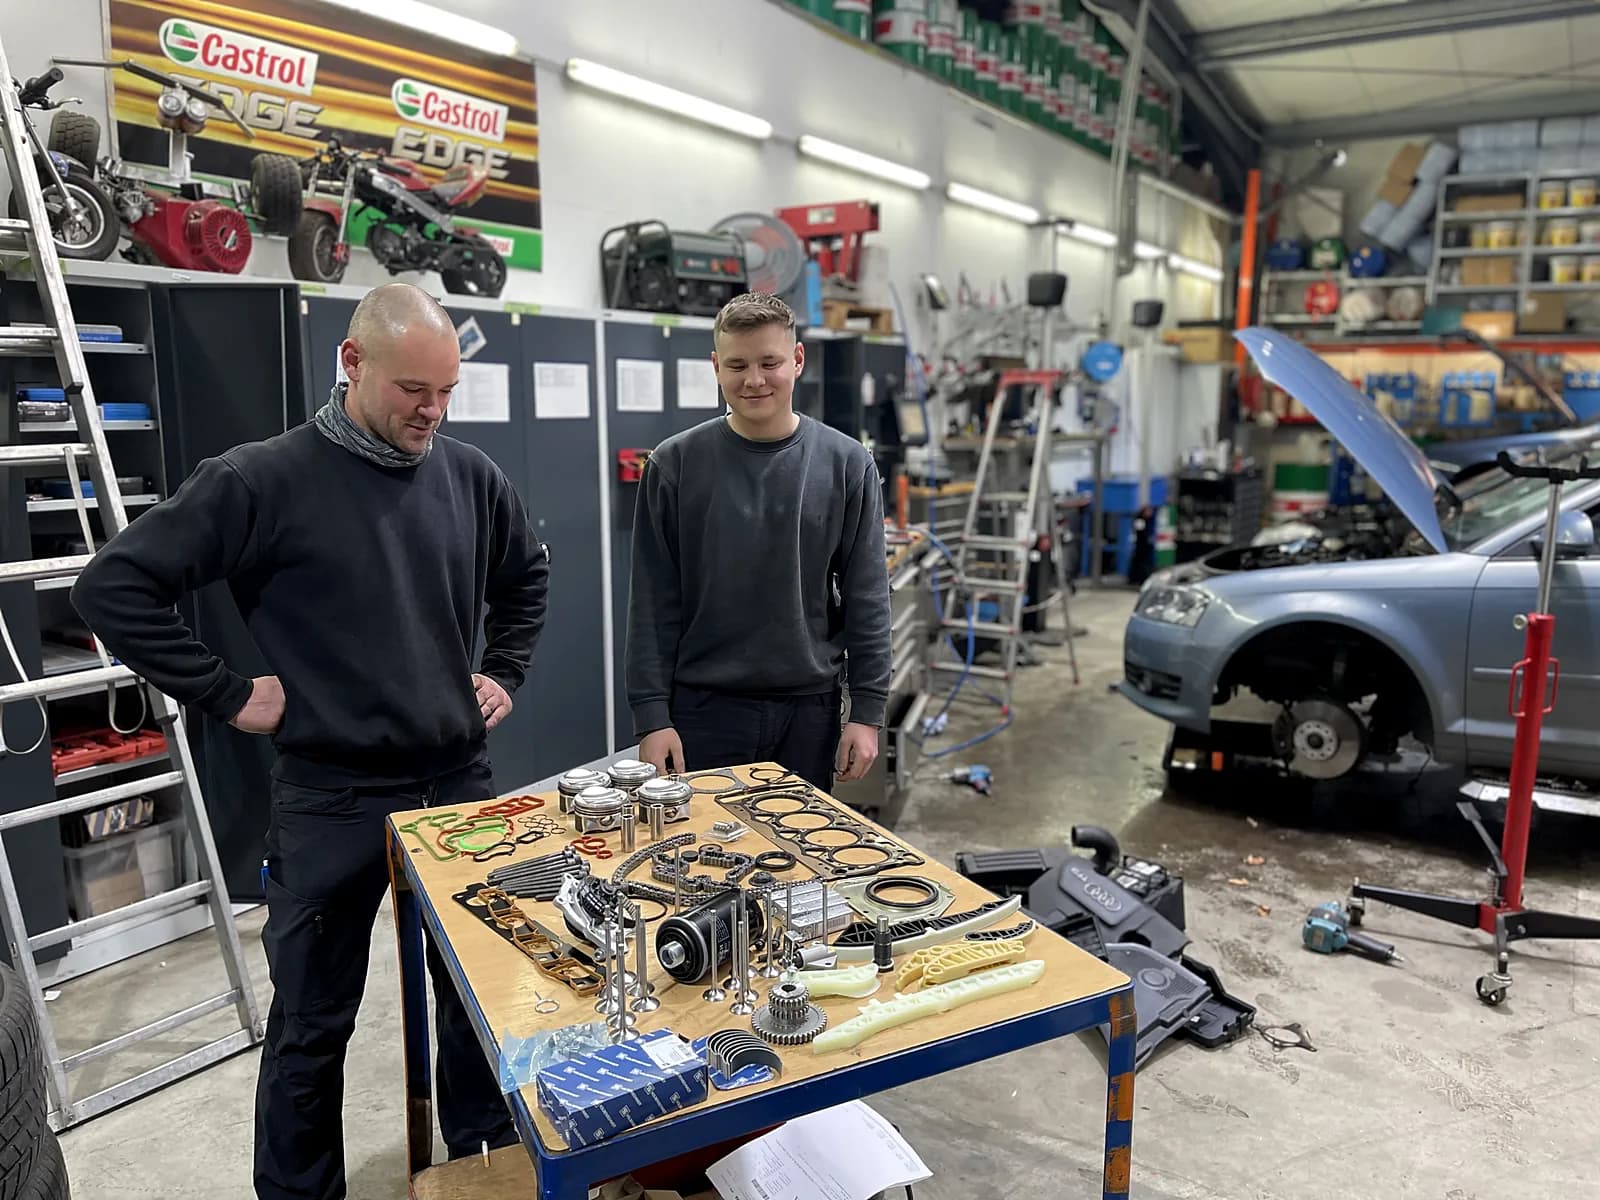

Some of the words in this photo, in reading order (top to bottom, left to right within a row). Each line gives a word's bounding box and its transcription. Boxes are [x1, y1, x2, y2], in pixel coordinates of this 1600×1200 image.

[201, 33, 306, 87] Castrol
[423, 91, 499, 135] Castrol
[391, 126, 511, 179] EDGE
